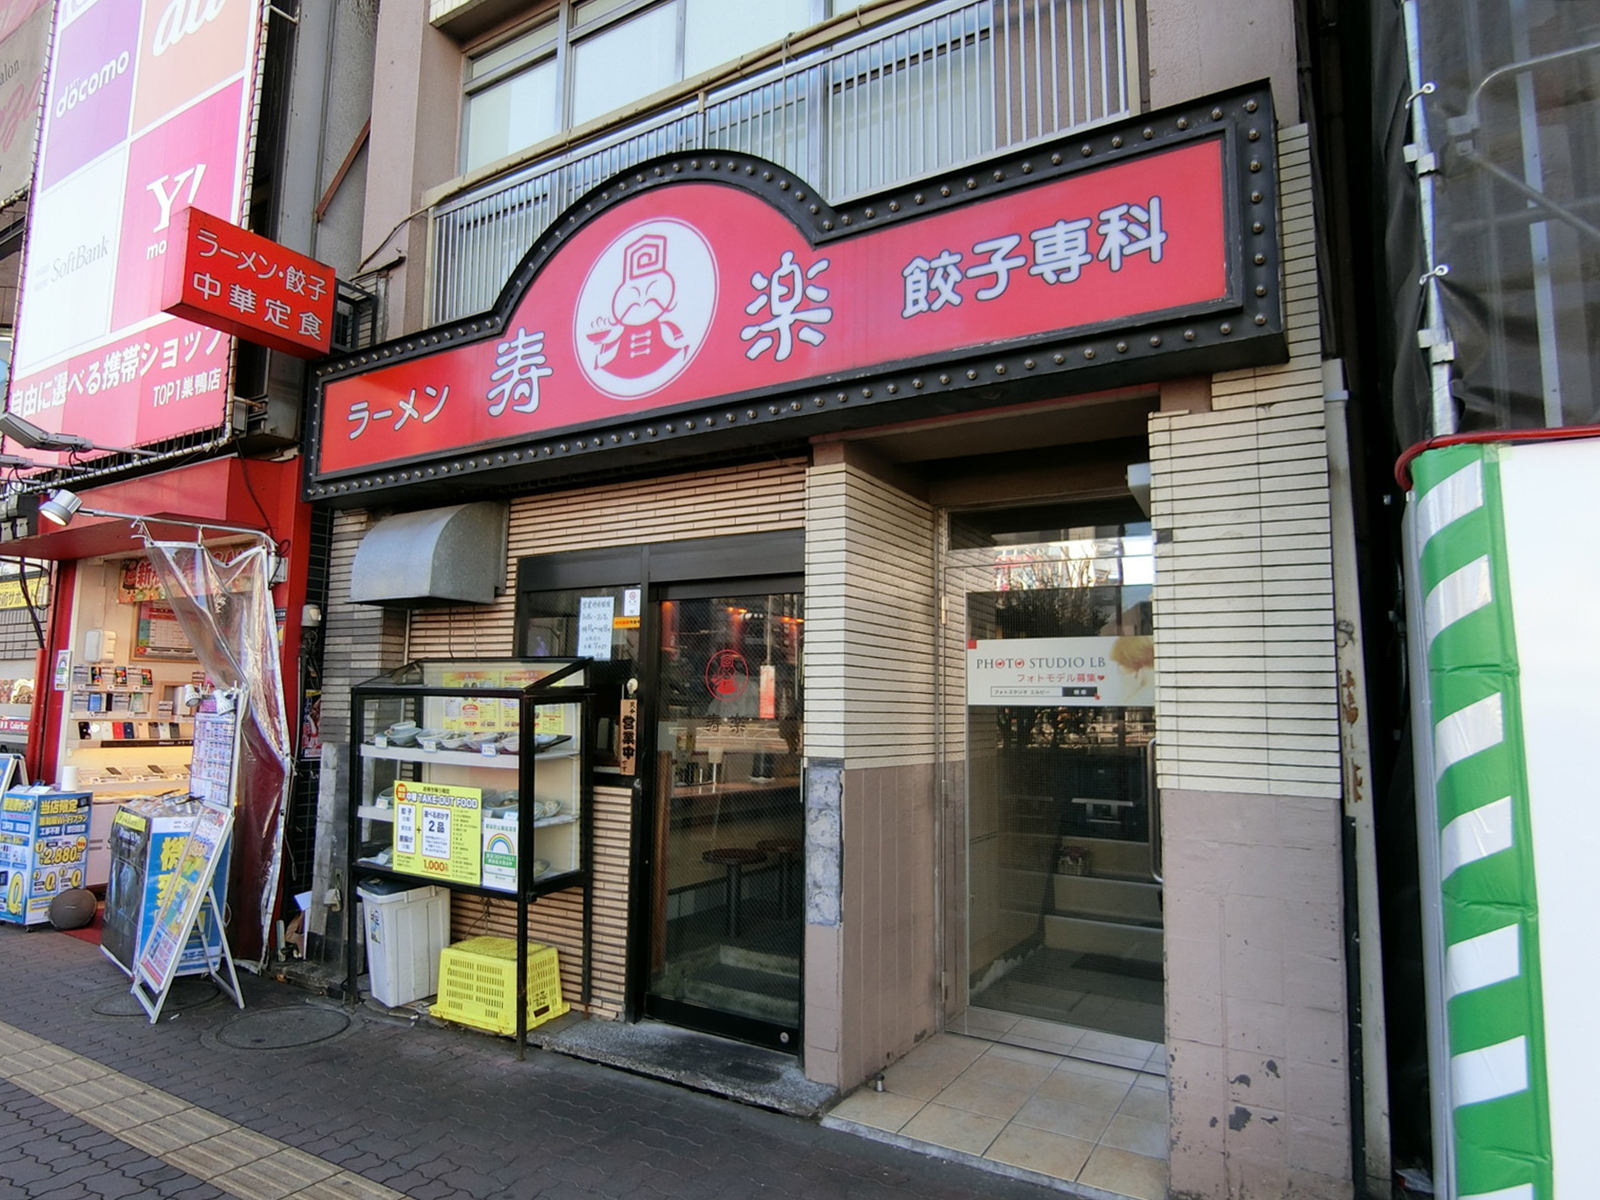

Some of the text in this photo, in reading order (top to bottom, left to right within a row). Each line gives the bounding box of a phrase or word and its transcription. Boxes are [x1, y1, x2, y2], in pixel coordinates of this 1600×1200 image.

[56, 50, 130, 118] docomo
[146, 163, 207, 233] Y!
[51, 236, 110, 283] SoftBank
[197, 229, 327, 301] ラーメン・餃子
[193, 271, 323, 341] 中華定食
[346, 195, 1169, 441] ラーメン 寿 楽 餃子専科
[153, 368, 221, 408] TOP1巣鴨店
[976, 656, 1106, 669] PHOTO STUDIO LB
[1017, 673, 1096, 683] フォトモデル募集
[40, 799, 78, 815] 当店限定
[456, 796, 479, 810] FOOD
